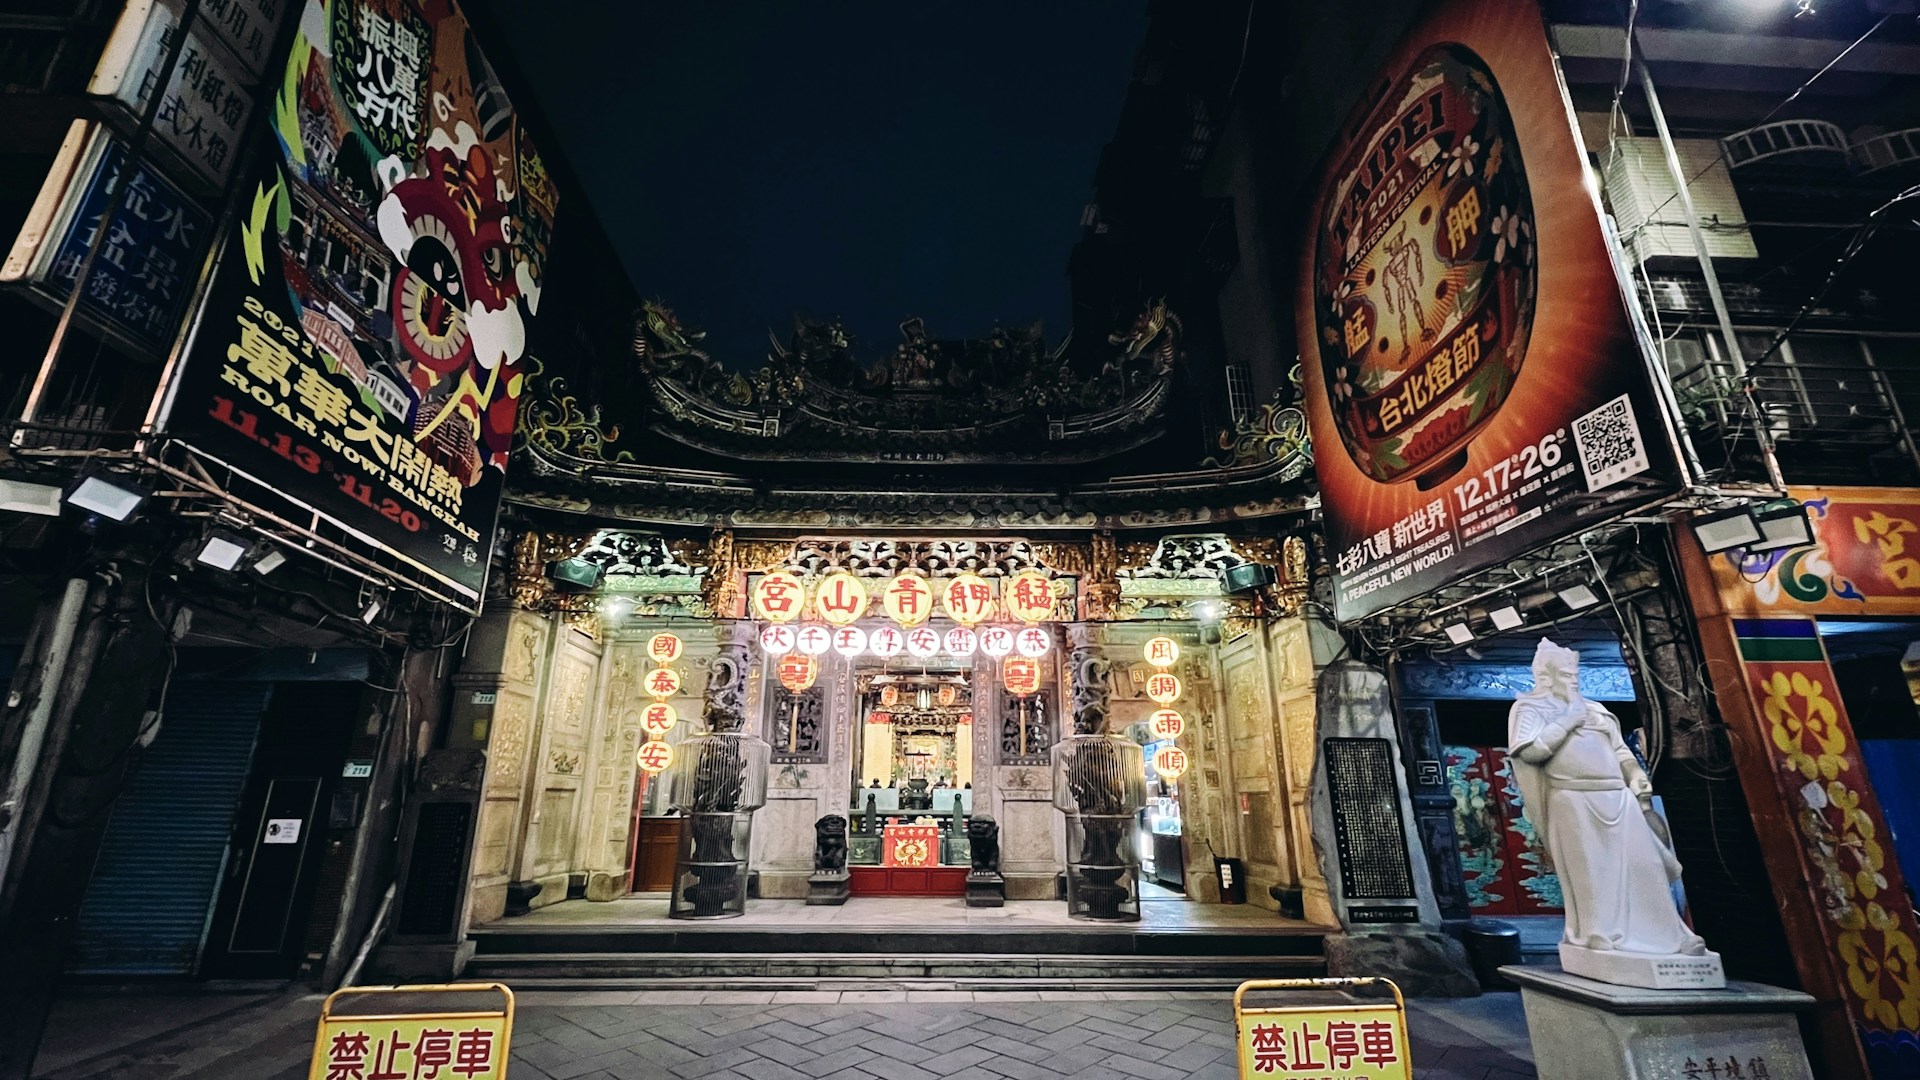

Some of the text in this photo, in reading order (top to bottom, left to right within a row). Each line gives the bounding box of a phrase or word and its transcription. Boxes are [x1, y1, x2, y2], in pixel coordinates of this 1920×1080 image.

[1334, 91, 1444, 248] TAIPEI
[1349, 161, 1441, 269] LANTERN FESTIVAL
[1369, 169, 1405, 220] 2021
[243, 296, 314, 360] 2021
[1378, 322, 1479, 433] 台北燈節
[220, 364, 481, 543] ROAR NOW! BANGKAH
[227, 314, 463, 515] 萬華大鬧熱
[1336, 528, 1392, 577] 七彩八寶
[1392, 498, 1447, 549] 新世界
[1348, 574, 1391, 601] PEACEFUL
[1391, 562, 1413, 584] NEW
[1412, 543, 1455, 573] WORLD!
[640, 636, 677, 769] 國泰民安
[1150, 640, 1184, 774] 風調雨順
[326, 1027, 494, 1080] 禁止停車
[1251, 1020, 1398, 1073] 禁止停車
